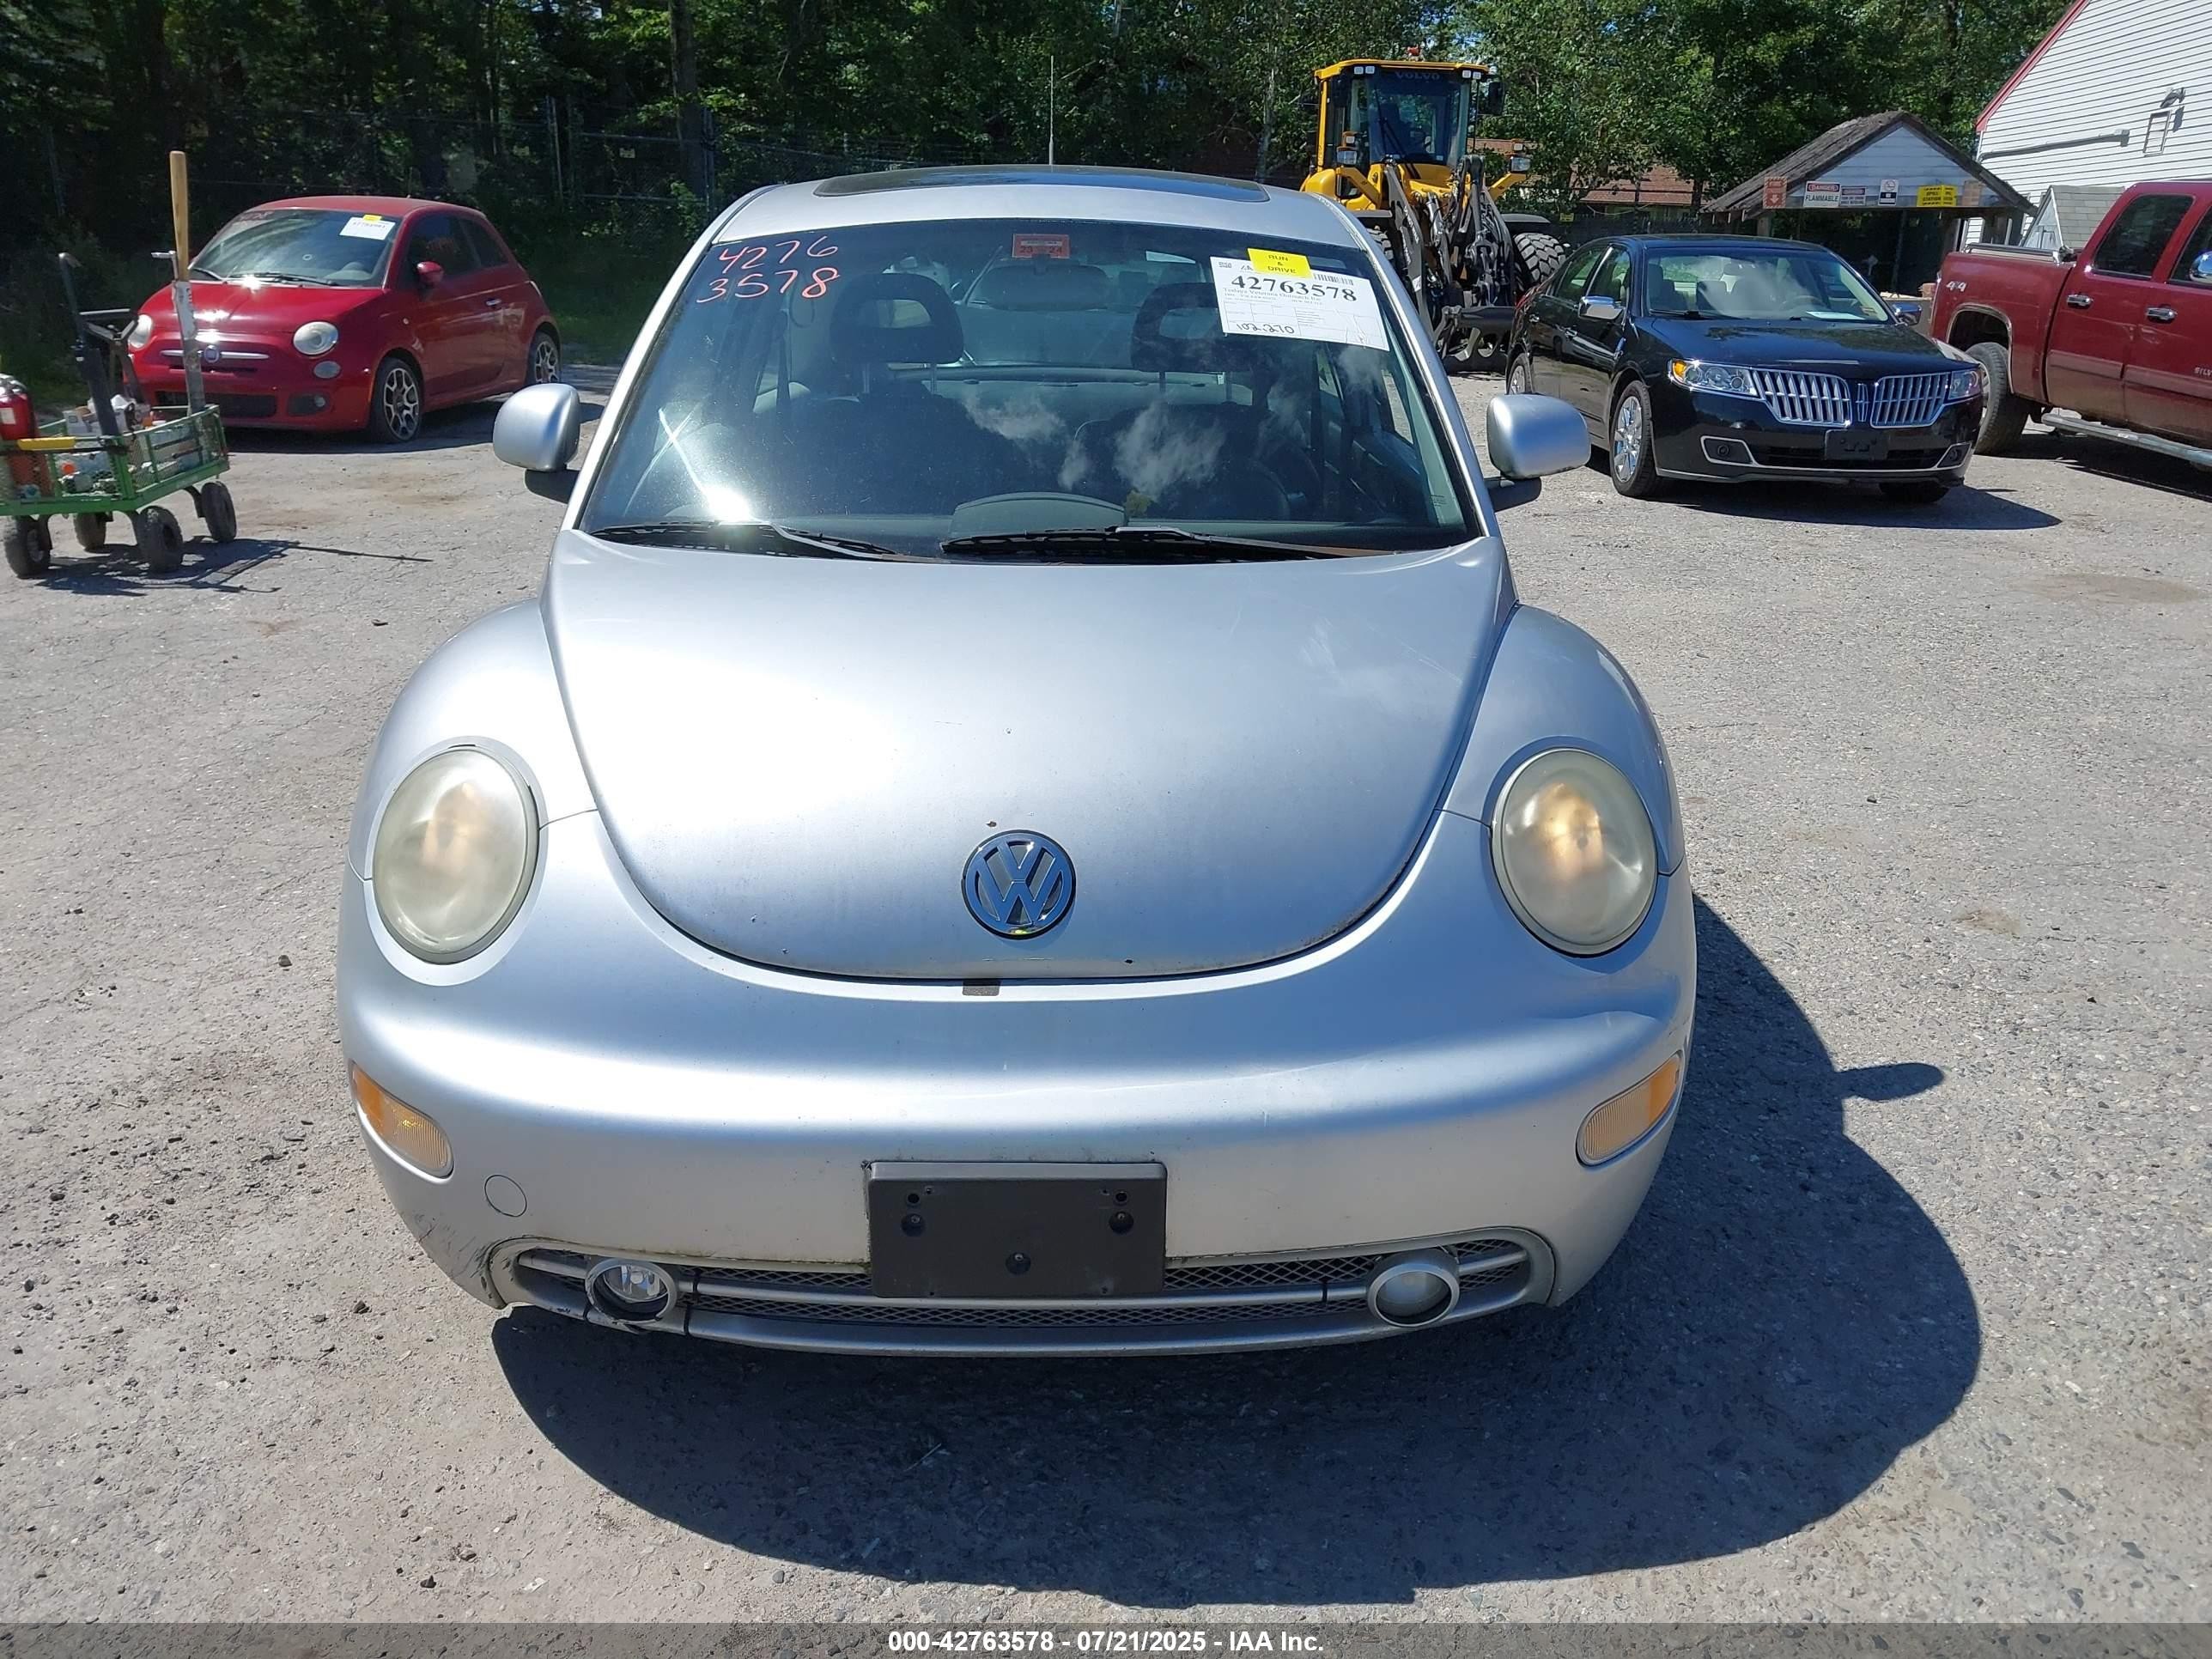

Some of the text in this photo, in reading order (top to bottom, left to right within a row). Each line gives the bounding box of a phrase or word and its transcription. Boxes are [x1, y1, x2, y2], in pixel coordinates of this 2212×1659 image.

[1395, 71, 1440, 81] VOLVO
[719, 236, 839, 274] 4276
[1267, 265, 1297, 274] DRIVE
[696, 267, 841, 303] 3578
[1231, 275, 1358, 302] 42763578
[965, 833, 1075, 938] VW
